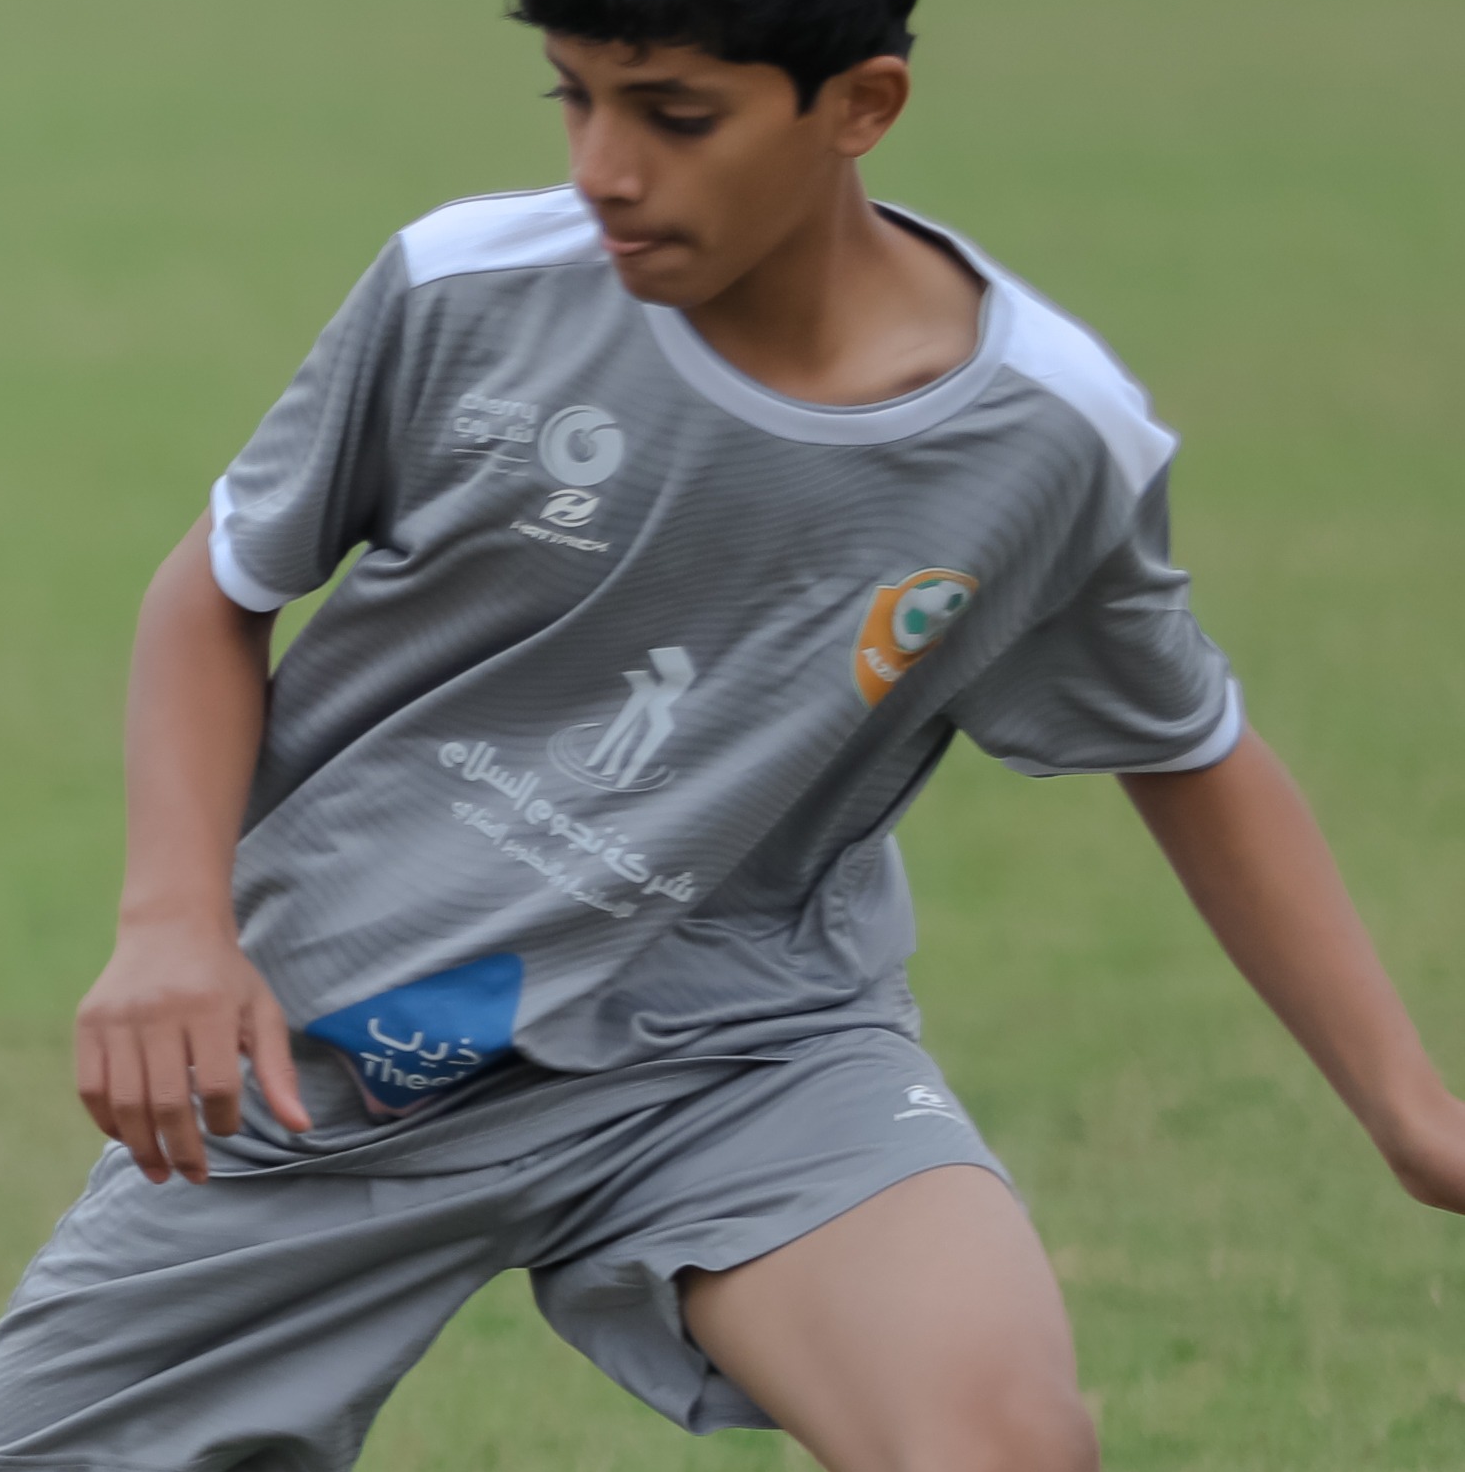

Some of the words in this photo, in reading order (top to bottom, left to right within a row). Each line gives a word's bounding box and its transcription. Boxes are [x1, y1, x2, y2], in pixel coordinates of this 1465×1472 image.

[438, 740, 542, 811] السلام
[524, 799, 616, 854] نجوم
[602, 833, 696, 903] شركة
[367, 1017, 482, 1068] ذيب
